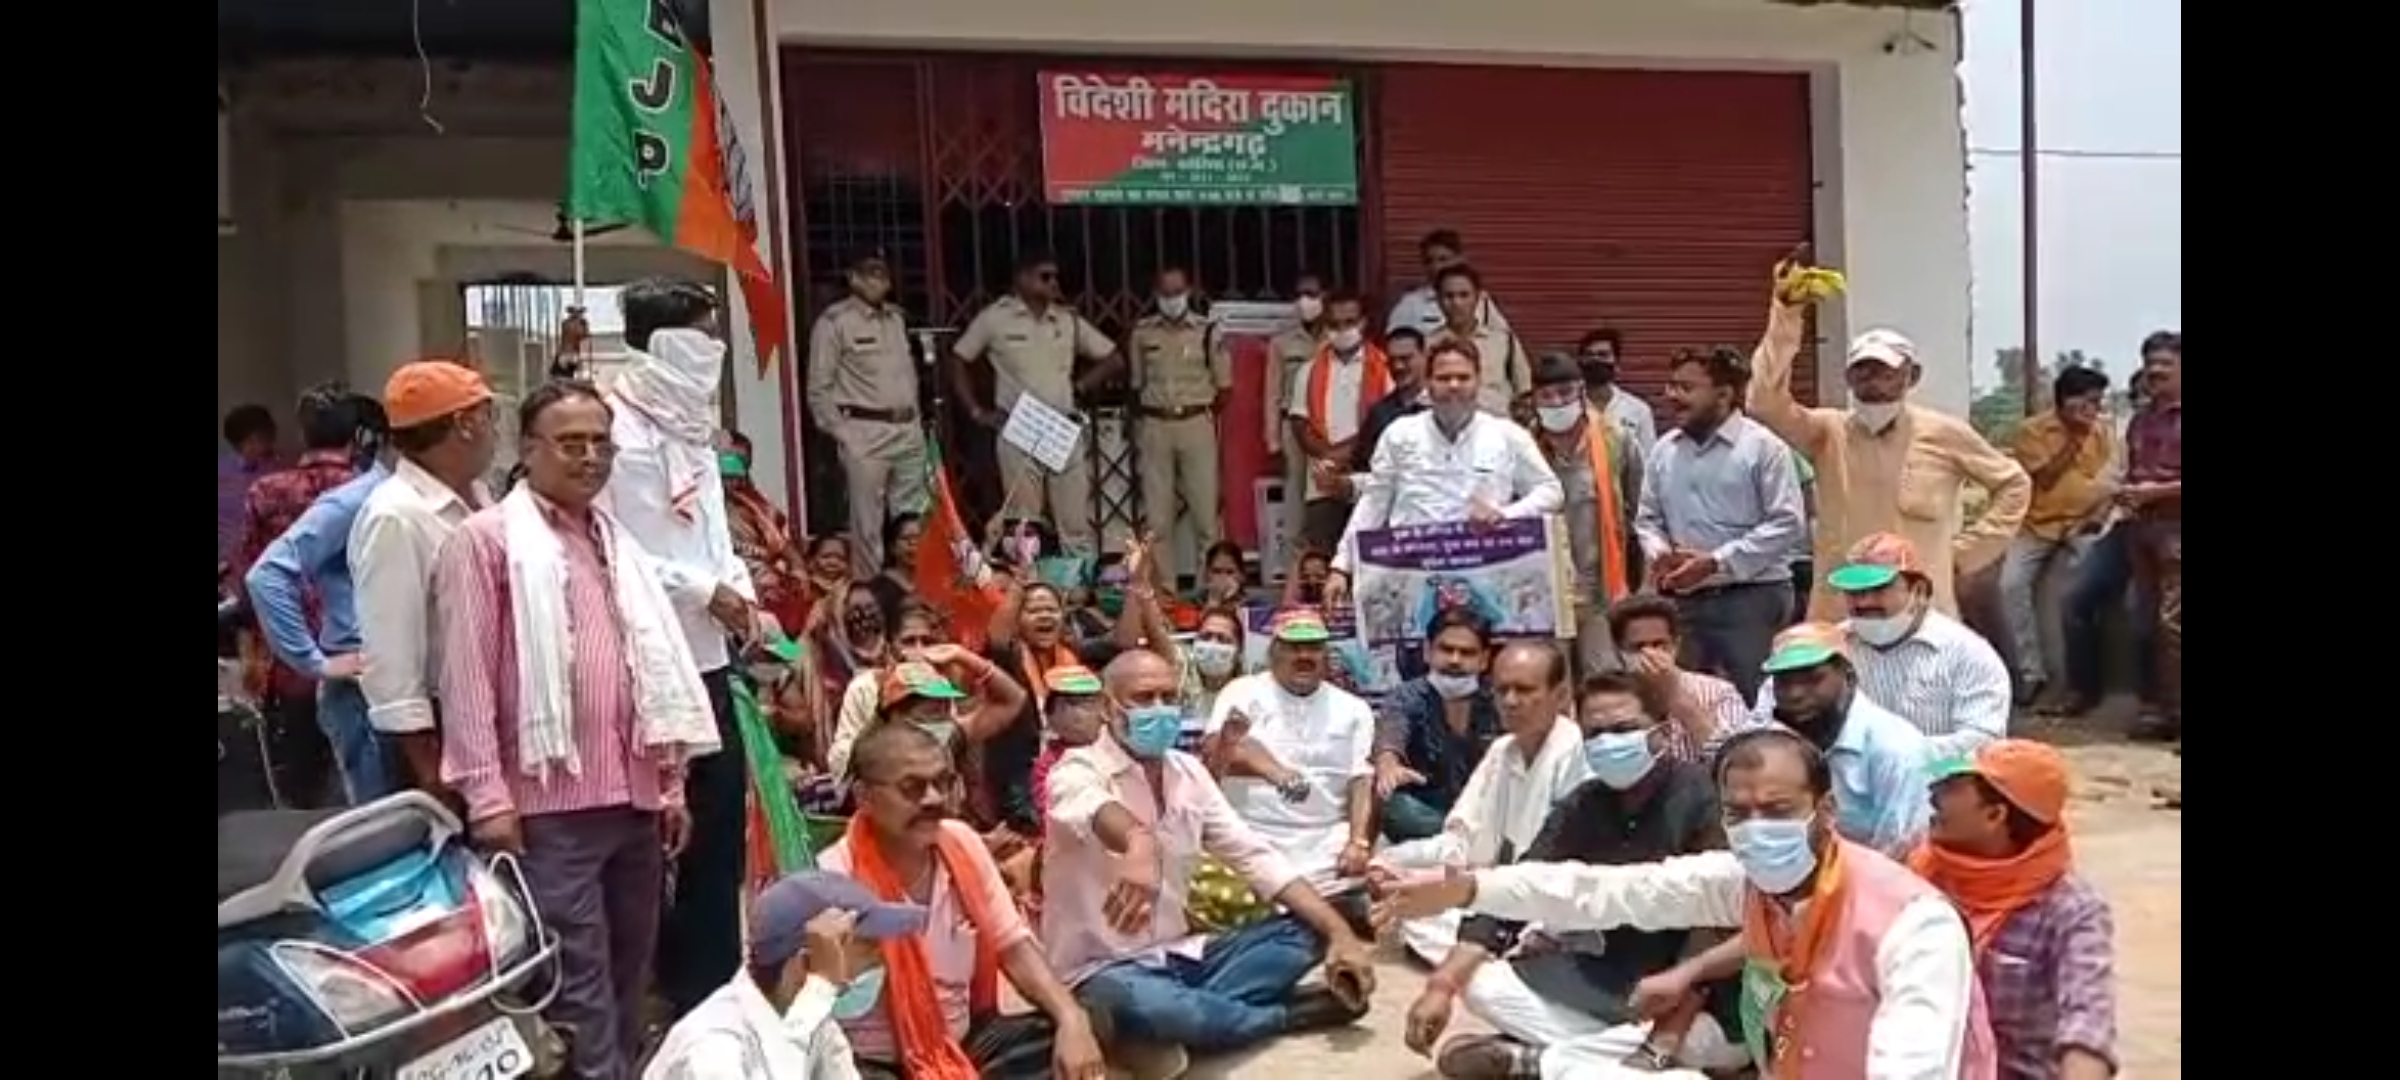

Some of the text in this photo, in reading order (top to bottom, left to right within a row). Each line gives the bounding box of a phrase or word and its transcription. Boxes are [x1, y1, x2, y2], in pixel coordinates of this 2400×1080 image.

[1053, 75, 1342, 134] विदेशी मदिरा दुकान
